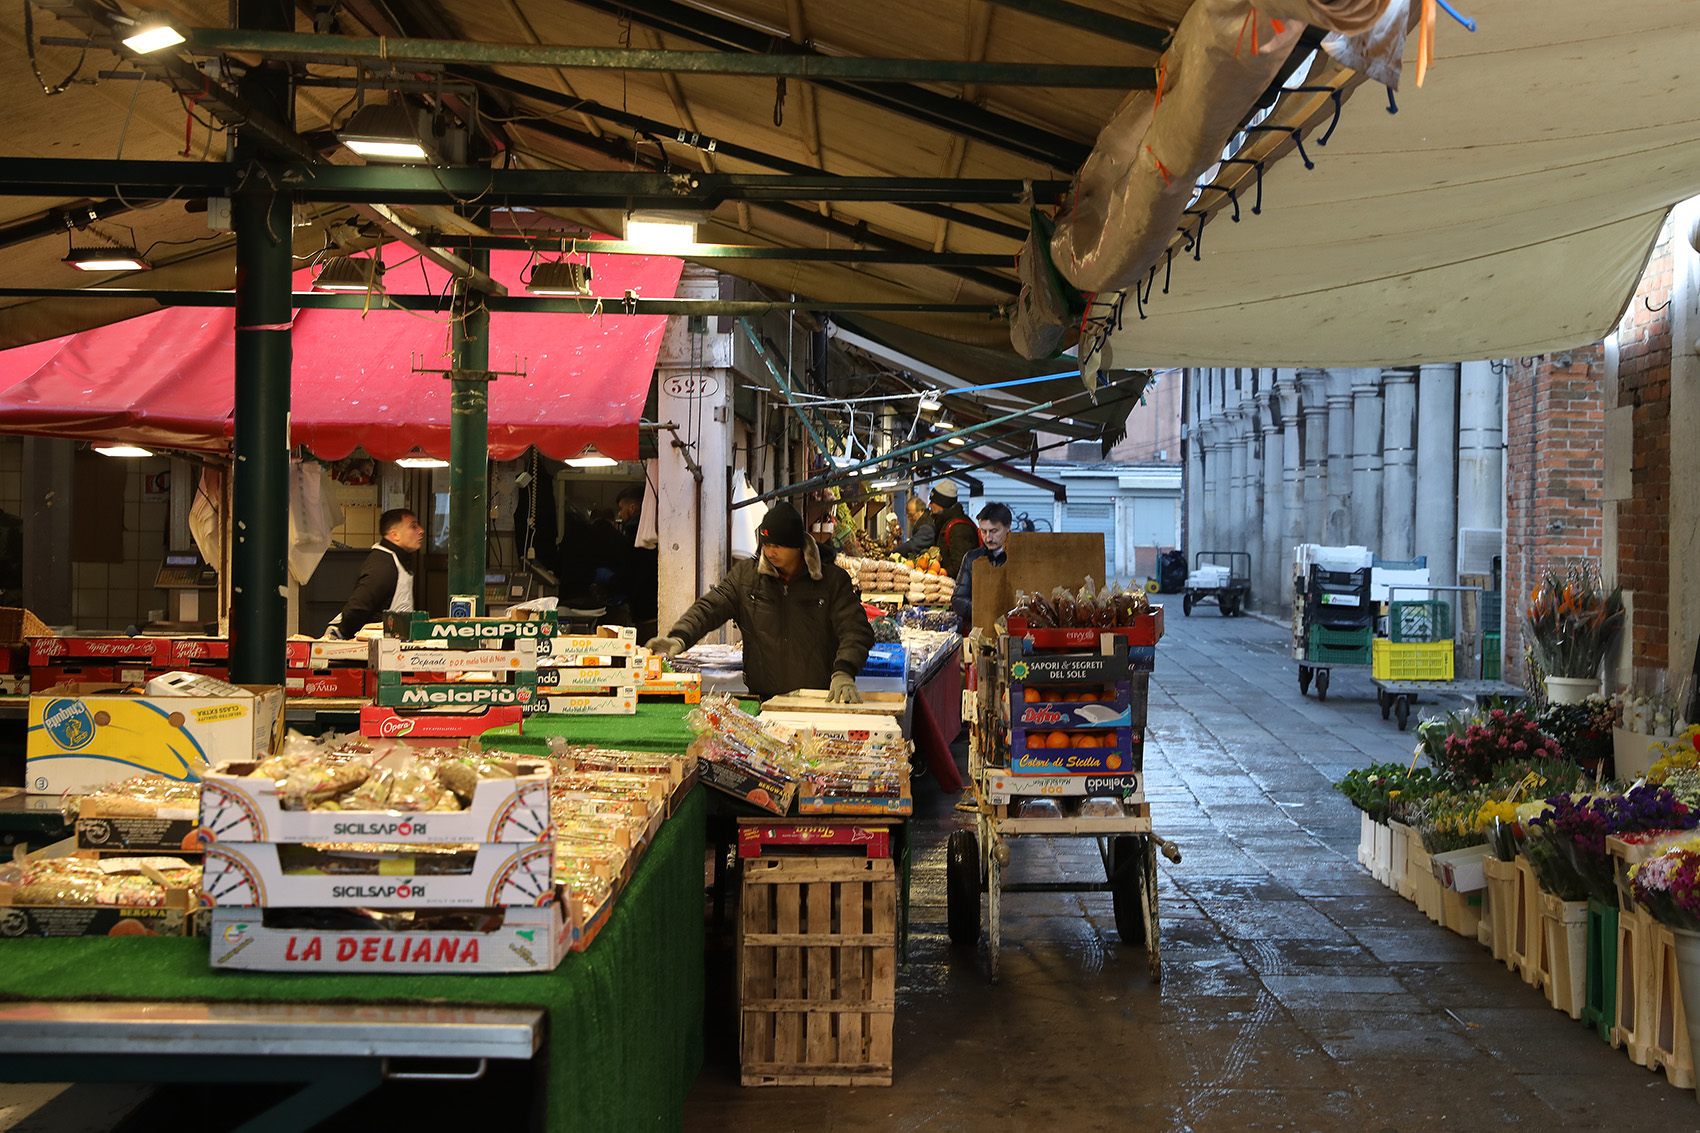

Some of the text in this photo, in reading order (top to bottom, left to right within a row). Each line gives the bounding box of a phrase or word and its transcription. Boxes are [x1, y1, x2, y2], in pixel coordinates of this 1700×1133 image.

[672, 379, 707, 393] 327
[431, 622, 538, 637] MelaPiù
[86, 642, 111, 654] Lady
[110, 642, 135, 654] Pink
[1030, 661, 1060, 670] SAPORI
[1071, 661, 1103, 670] SEGRETI
[580, 670, 600, 678] DOP
[1050, 670, 1087, 679] DEL SOLE
[316, 680, 338, 692] envy
[402, 689, 515, 703] MelaPiù
[45, 701, 86, 729] Chiquita
[197, 705, 239, 716] CLASS EXTRA
[1024, 703, 1062, 724] Delfino
[384, 721, 409, 734] Opera
[1019, 754, 1101, 768] Colori di Sicilia
[1040, 786, 1063, 794] DOP
[1087, 777, 1136, 791] Melinda
[796, 826, 835, 838] Tania
[285, 937, 323, 962] LA
[336, 937, 481, 963] DELIANA
